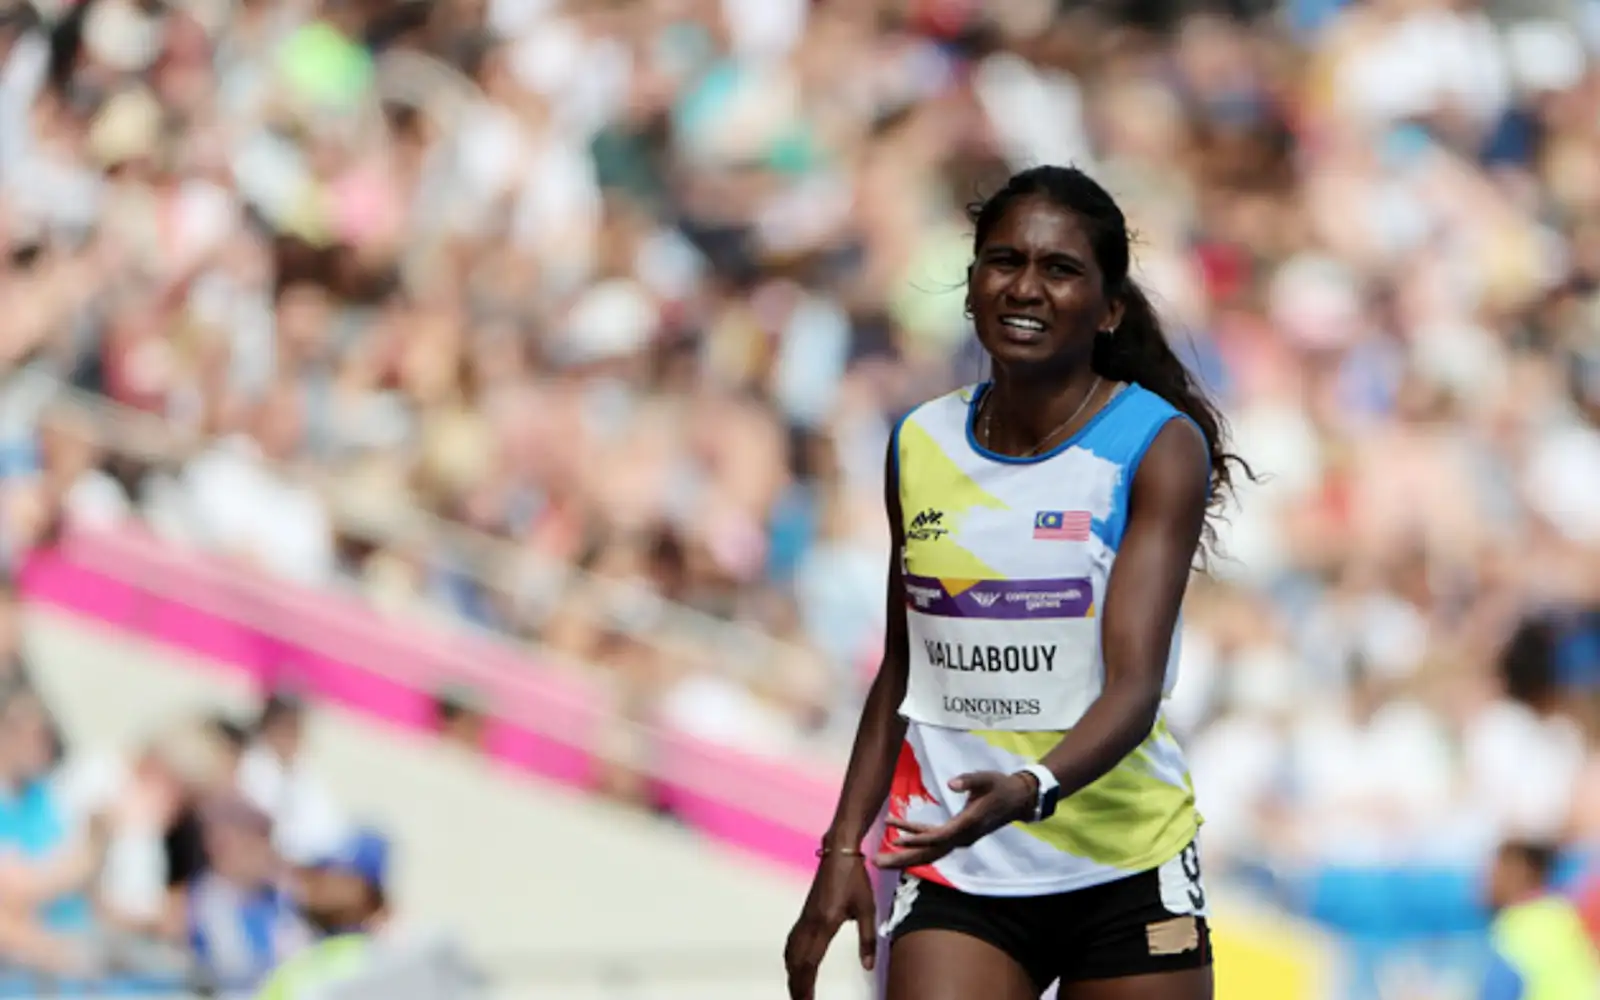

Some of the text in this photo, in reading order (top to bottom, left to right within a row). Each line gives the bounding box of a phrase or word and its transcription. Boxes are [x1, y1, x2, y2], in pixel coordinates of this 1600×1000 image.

[1025, 600, 1061, 612] games
[924, 639, 1057, 672] VALLABOUY
[943, 696, 1041, 715] LONGINES
